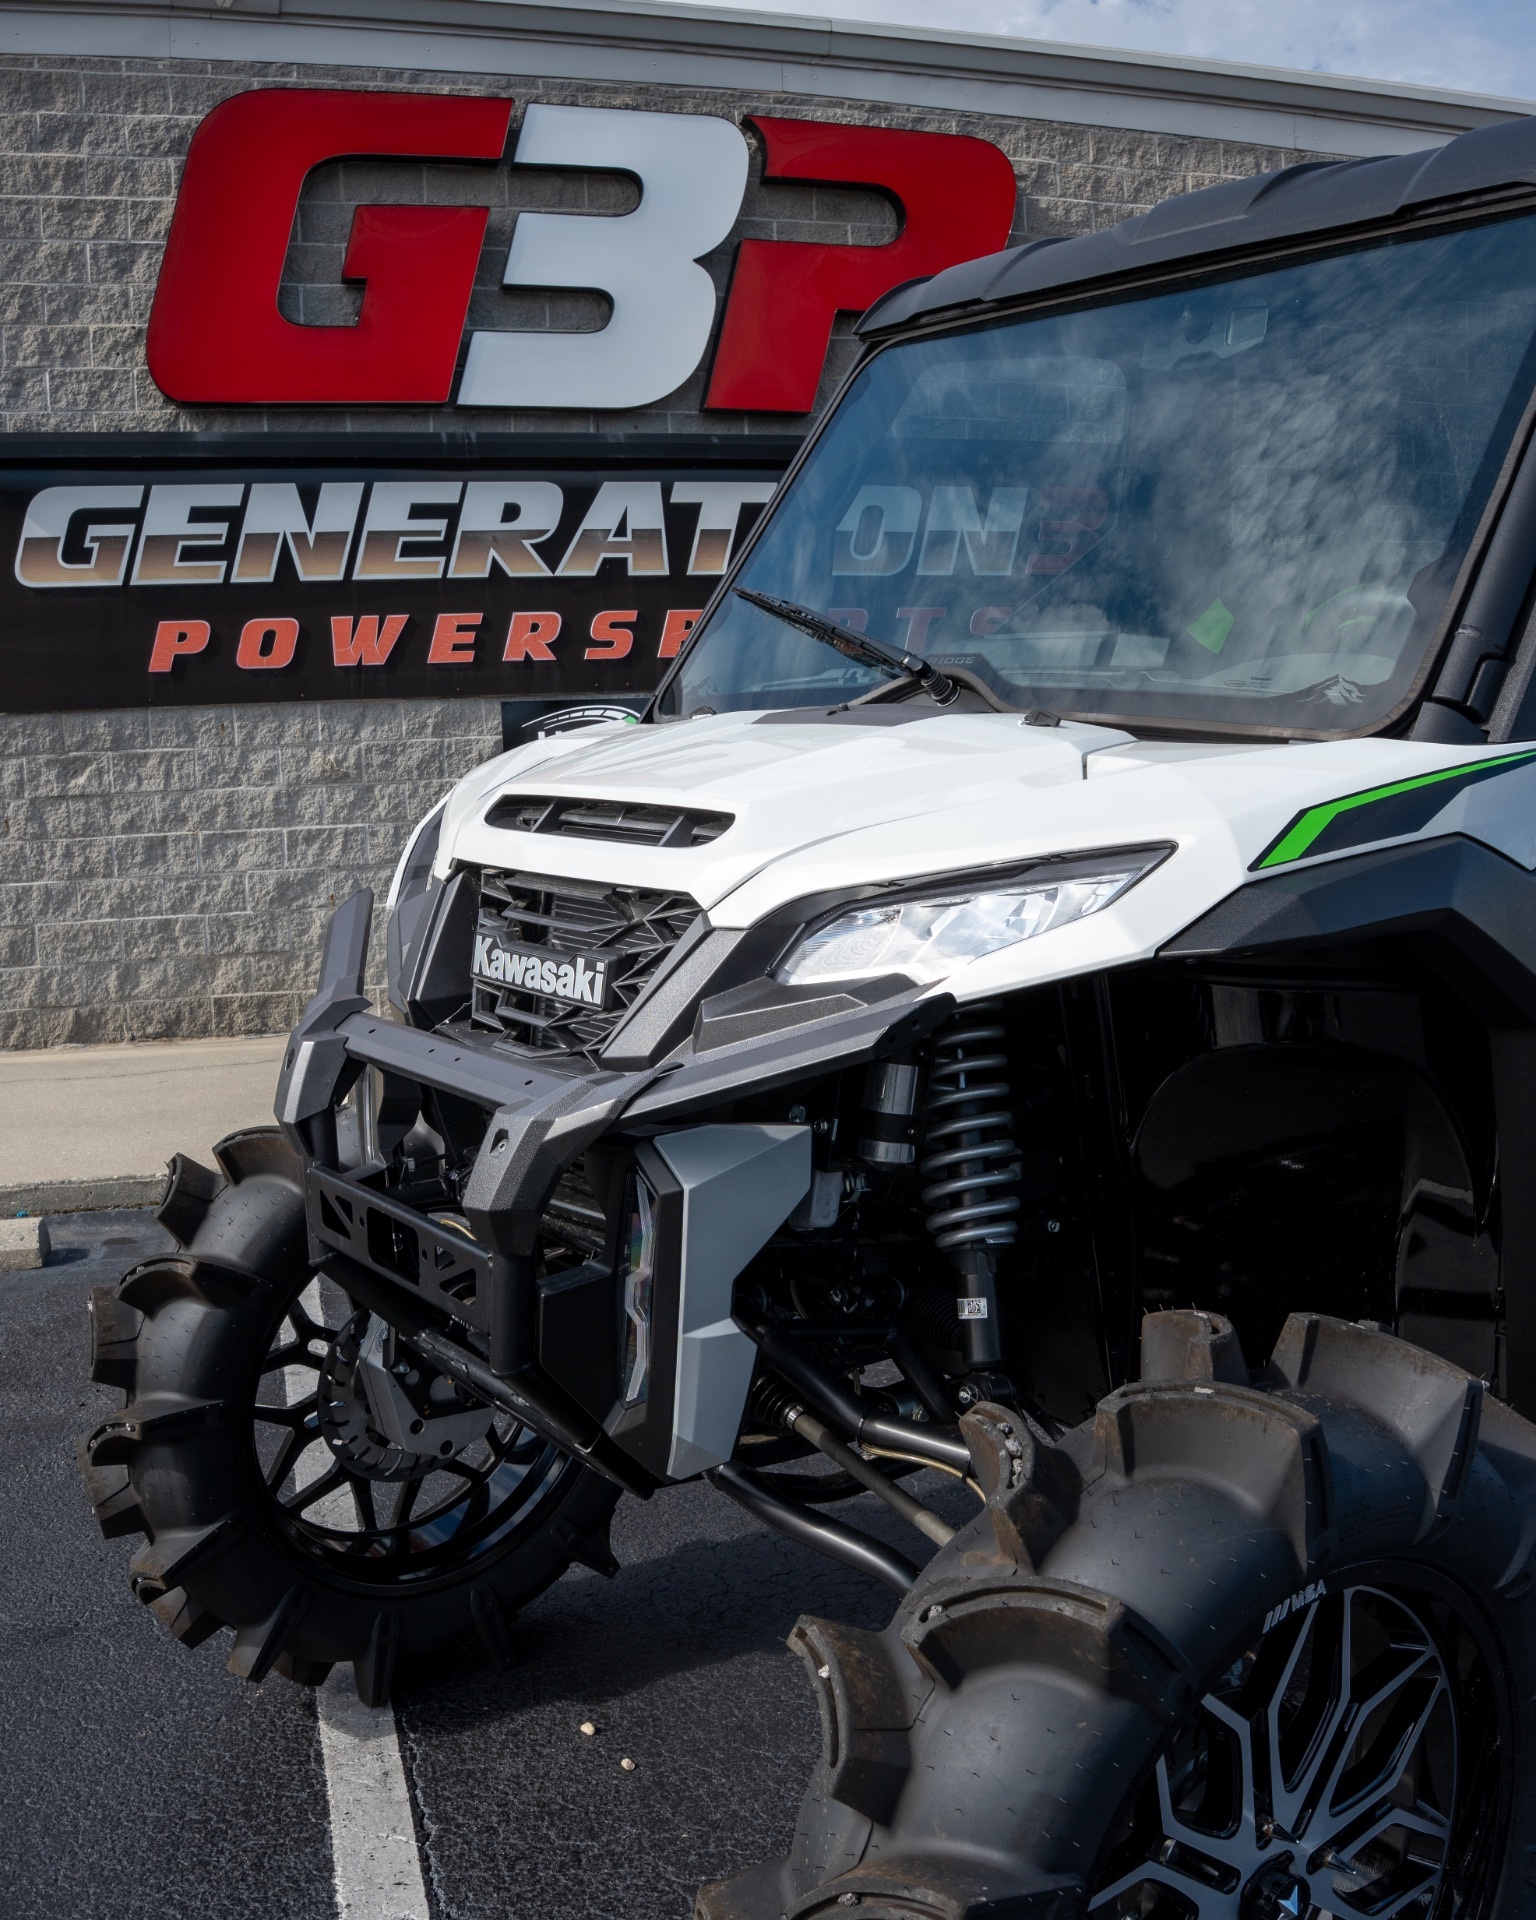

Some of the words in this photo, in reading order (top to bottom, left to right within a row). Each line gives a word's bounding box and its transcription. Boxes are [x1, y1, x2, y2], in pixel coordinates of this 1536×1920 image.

[146, 87, 1017, 413] G3P
[14, 480, 1108, 588] GENERATON3
[147, 607, 1013, 673] POWERSPTS
[927, 656, 976, 665] RIDGE
[472, 935, 604, 1005] Kawasaki
[1291, 1579, 1327, 1612] MSA
